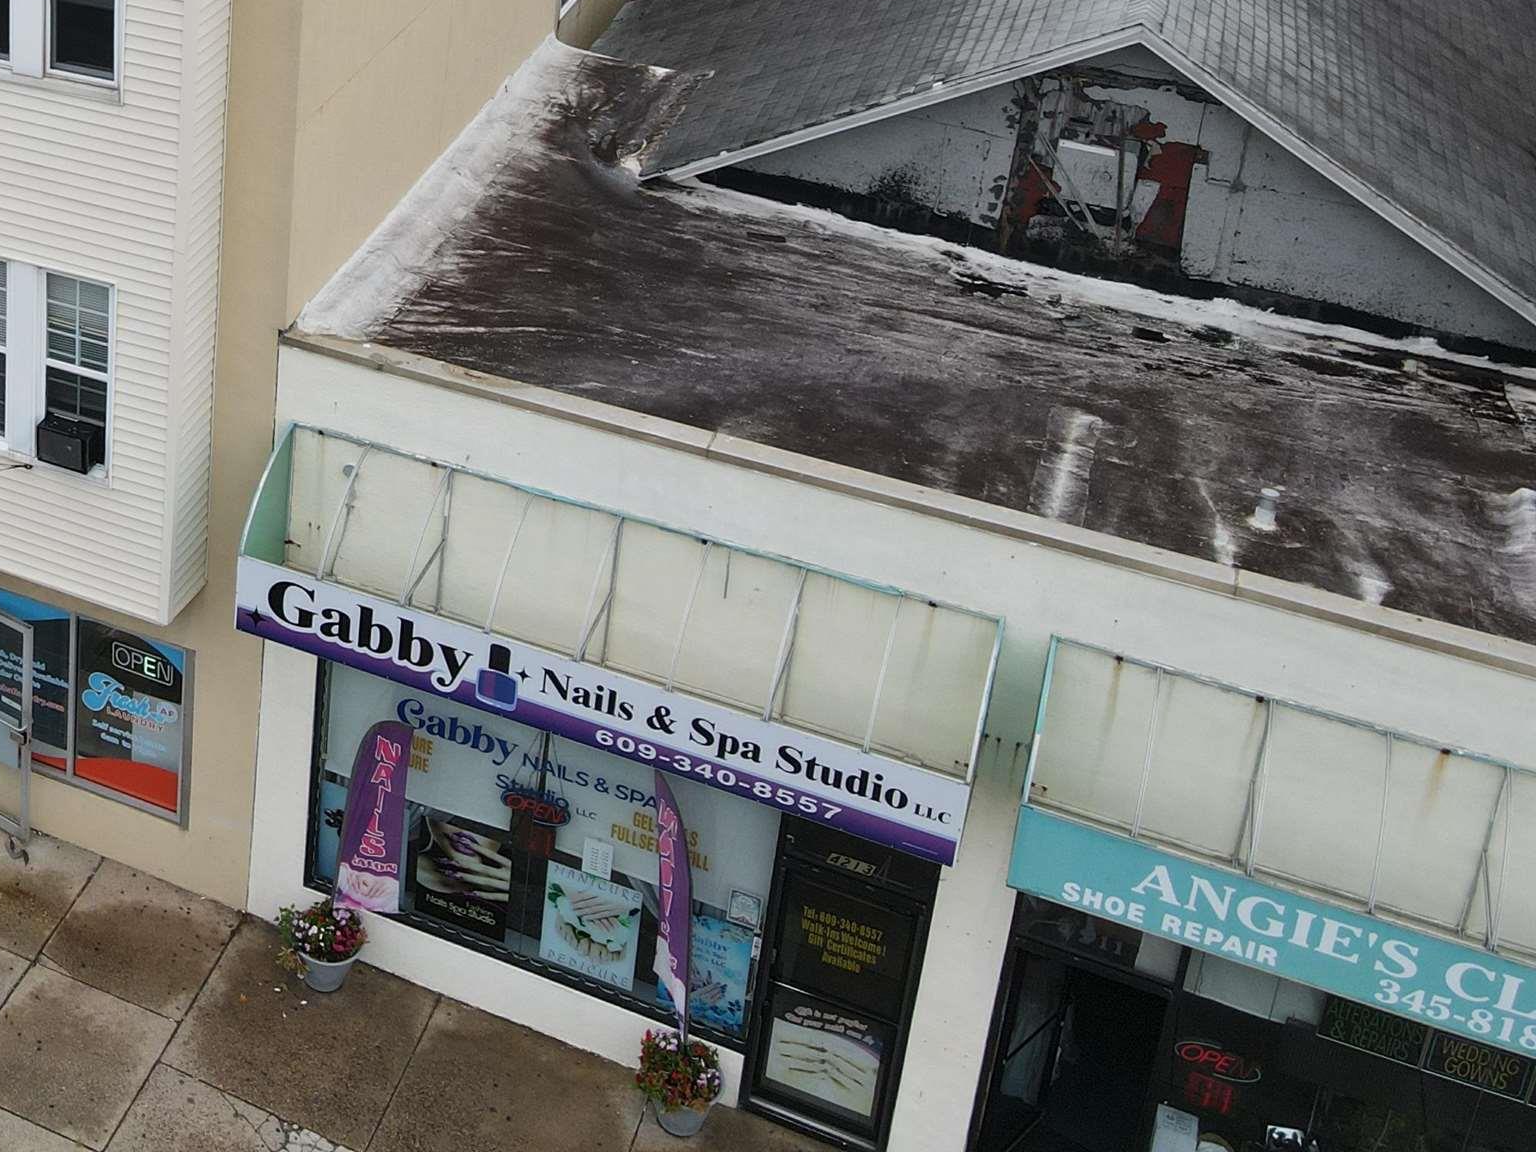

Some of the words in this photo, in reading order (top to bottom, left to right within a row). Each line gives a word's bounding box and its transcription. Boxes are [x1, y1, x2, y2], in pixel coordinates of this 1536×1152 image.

[115, 647, 171, 682] OPEN
[82, 672, 151, 711] Fresh
[267, 581, 473, 687] Gabby
[539, 667, 634, 721] Nails
[646, 705, 677, 734] &
[689, 717, 762, 763] Spa
[775, 745, 908, 810] Studio
[914, 802, 952, 824] LLC
[397, 698, 518, 766] Gabby
[523, 753, 590, 788] NAILS
[594, 777, 610, 794] &
[615, 783, 657, 810] SPA
[595, 729, 843, 820] 609-340-8557
[359, 734, 402, 858] NAILS
[507, 794, 563, 822] OPEN
[576, 807, 598, 821] LLC
[633, 811, 654, 833] GEL
[826, 853, 877, 876] 4213
[1062, 882, 1146, 924] SHOE
[1161, 913, 1279, 967] REPAIR
[1131, 864, 1419, 978] ANGIE'S
[1327, 999, 1424, 1045] ALTERATIONS
[1374, 979, 1536, 1049] 345-818
[1330, 1020, 1346, 1040] &
[1350, 1025, 1410, 1060] REPAIRS
[1442, 1037, 1521, 1076] WEDDING
[1181, 1044, 1251, 1079] OPEN
[1444, 1056, 1510, 1090] GOWNS
